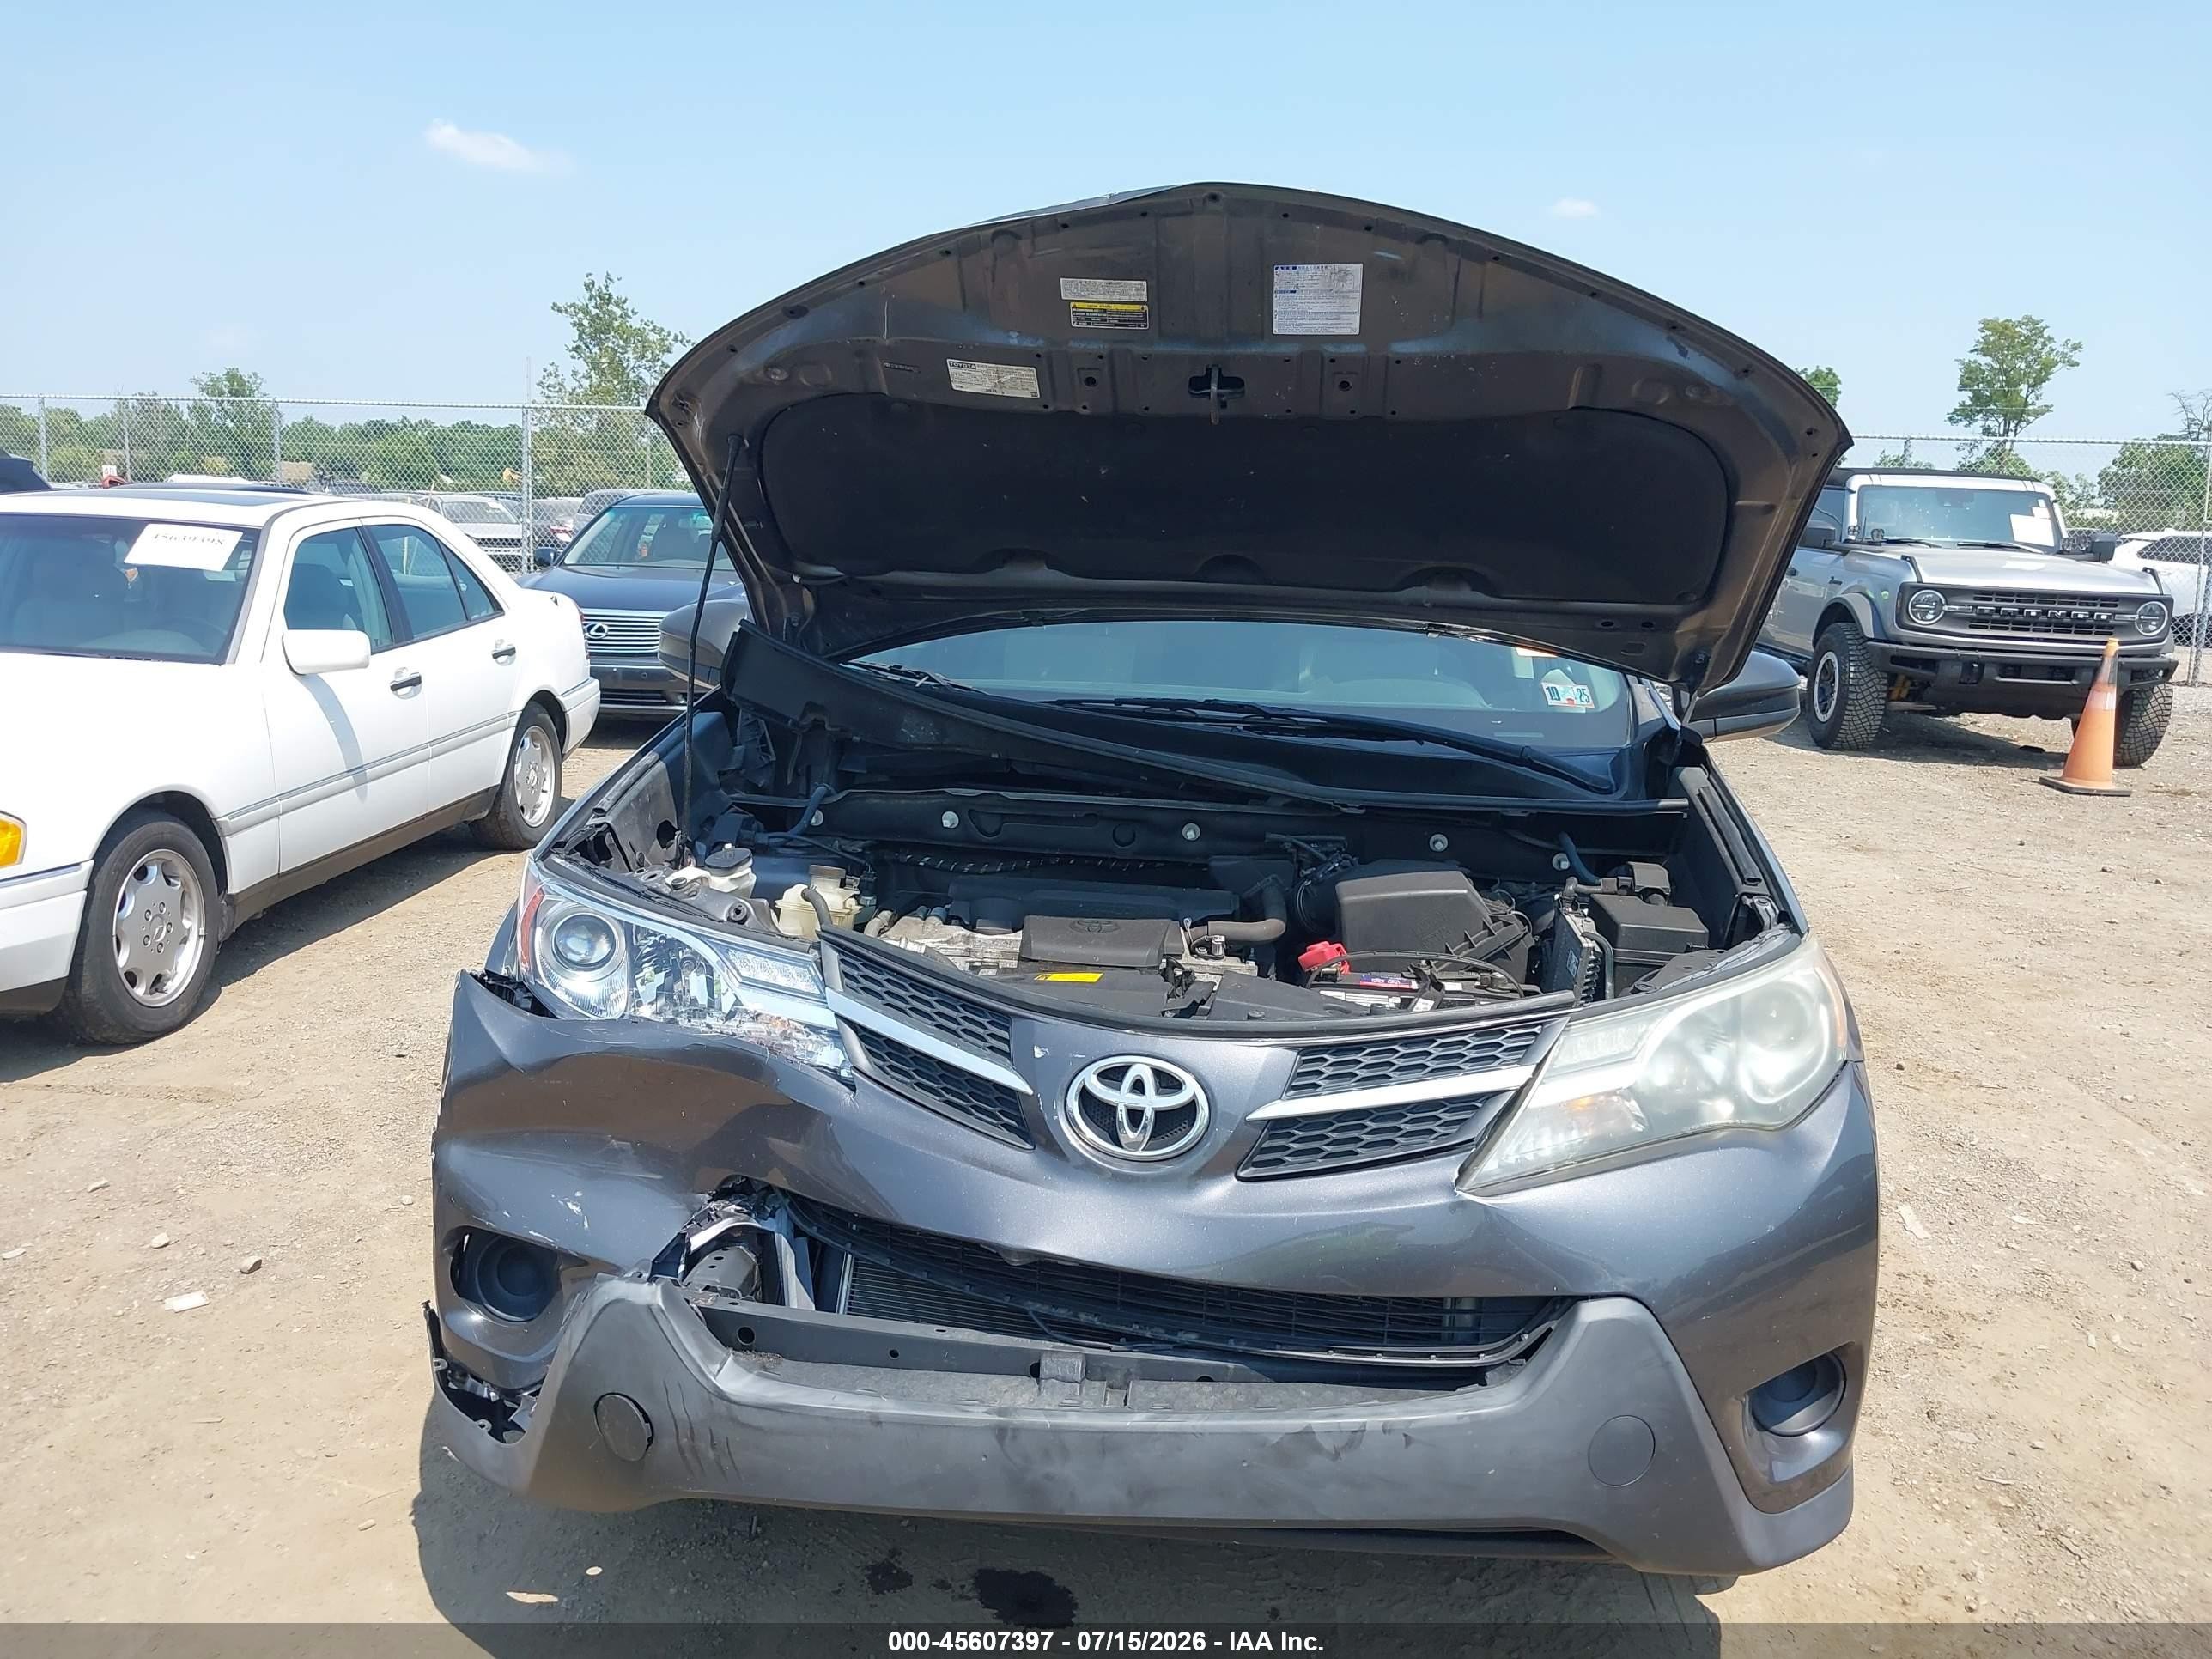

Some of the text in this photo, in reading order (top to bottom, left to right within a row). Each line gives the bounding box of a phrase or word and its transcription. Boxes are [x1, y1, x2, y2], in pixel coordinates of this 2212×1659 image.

[1977, 605, 2112, 621] BRONCO
[1546, 686, 1590, 703] 10 25
